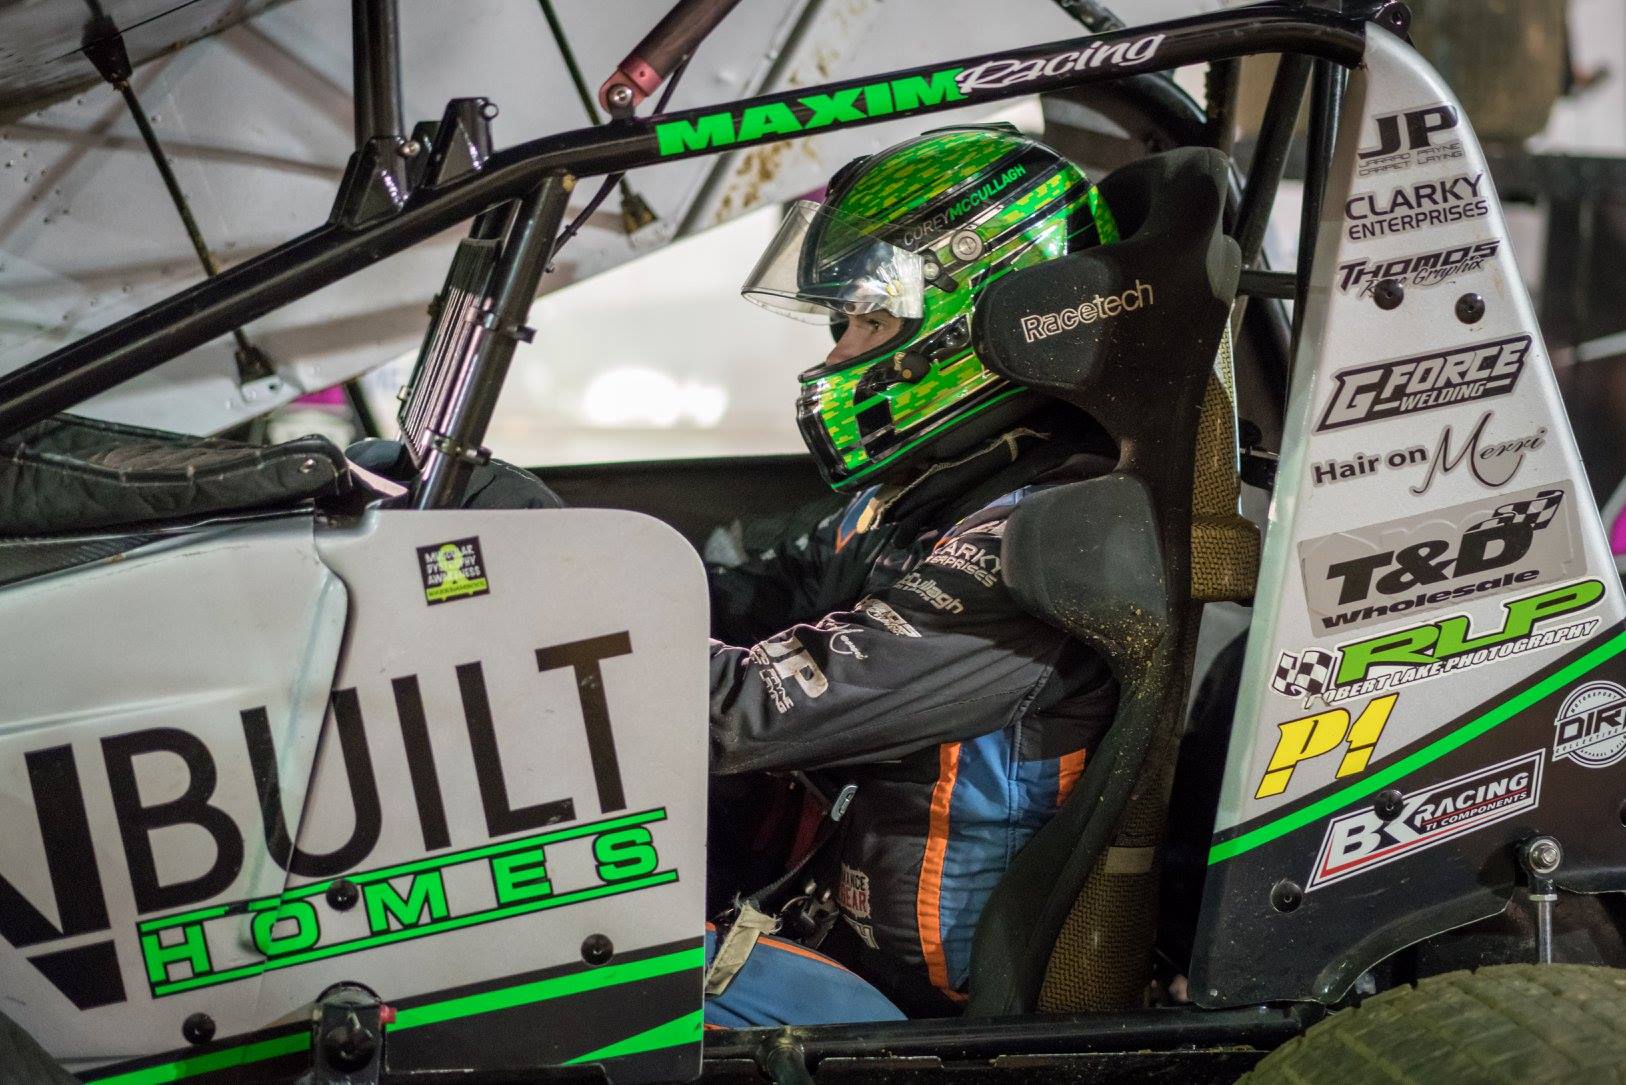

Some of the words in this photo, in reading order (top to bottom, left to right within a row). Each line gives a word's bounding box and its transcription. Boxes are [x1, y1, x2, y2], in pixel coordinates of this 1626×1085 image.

[656, 68, 971, 156] MAXIM
[955, 33, 1166, 95] Racing
[1358, 105, 1458, 160] JP
[1345, 174, 1483, 220] CLARKY
[1350, 200, 1488, 241] ENTERPRISES
[1021, 279, 1155, 343] Racetech
[1400, 381, 1488, 412] WELDING
[1314, 455, 1380, 484] Hair
[1388, 448, 1428, 468] on
[1326, 510, 1534, 606] T&D
[1335, 579, 1606, 686] RLP
[1391, 658, 1443, 687] LAKE
[1440, 619, 1600, 673] PHOTOGRAPHY
[1255, 692, 1399, 799] P1
[1557, 701, 1626, 747] DIR
[1326, 793, 1436, 871] BK
[1414, 772, 1530, 829] RACING
[1425, 822, 1437, 832] TI
[1440, 791, 1527, 828] COMPONENTS
[140, 825, 661, 986] HOMES
